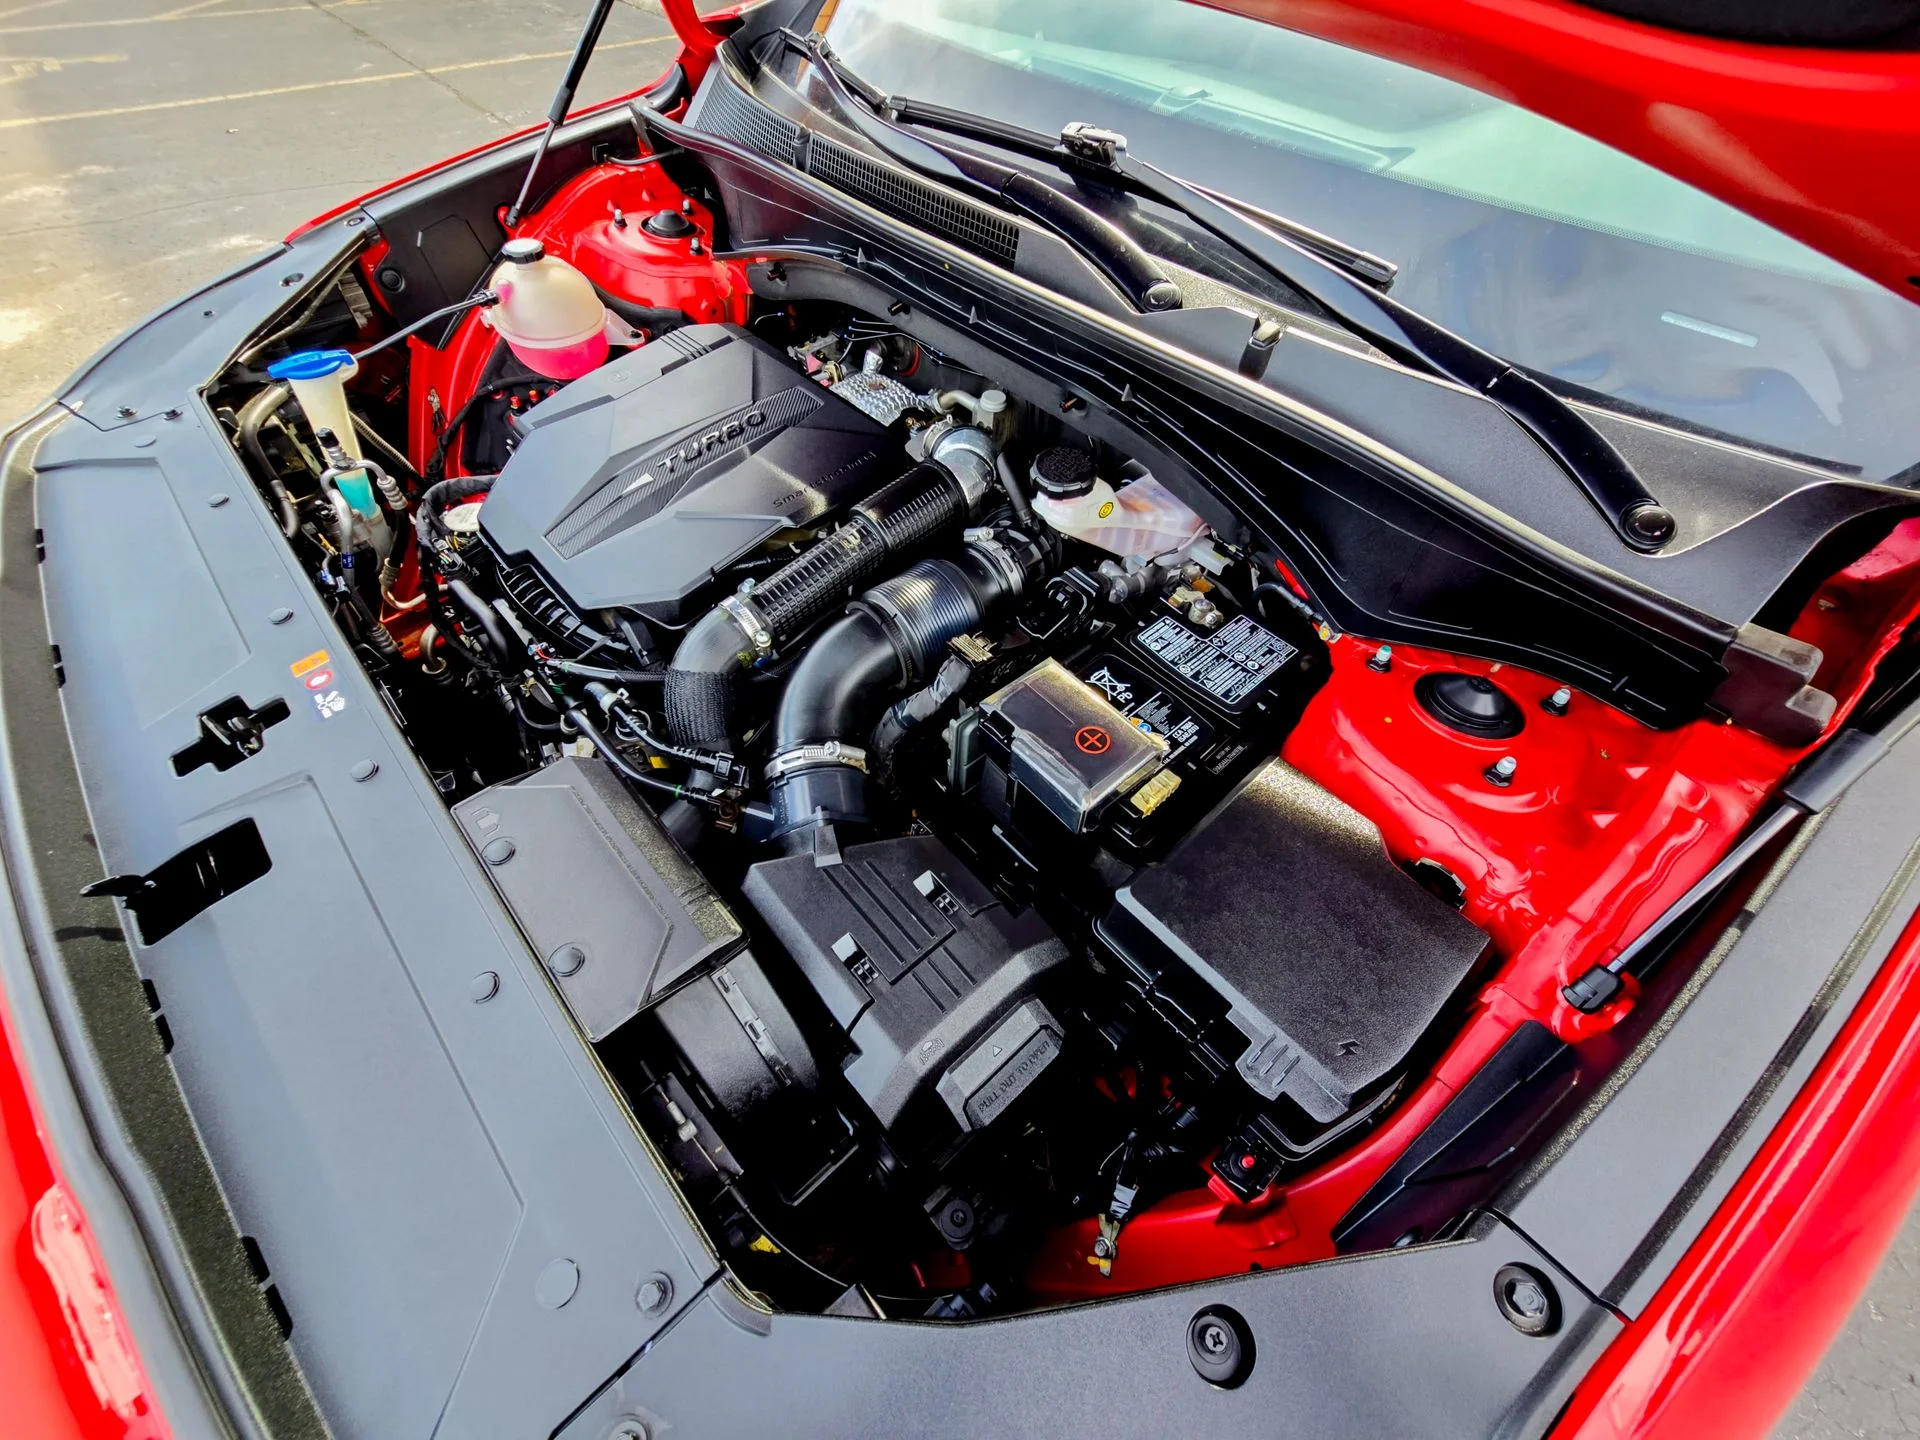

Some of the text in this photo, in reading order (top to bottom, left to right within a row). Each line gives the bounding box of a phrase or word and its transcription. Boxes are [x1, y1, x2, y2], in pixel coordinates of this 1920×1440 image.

[657, 409, 766, 473] TURBO
[1117, 691, 1133, 703] Pb
[978, 1041, 1050, 1113] PULL OUT TO OPEN
